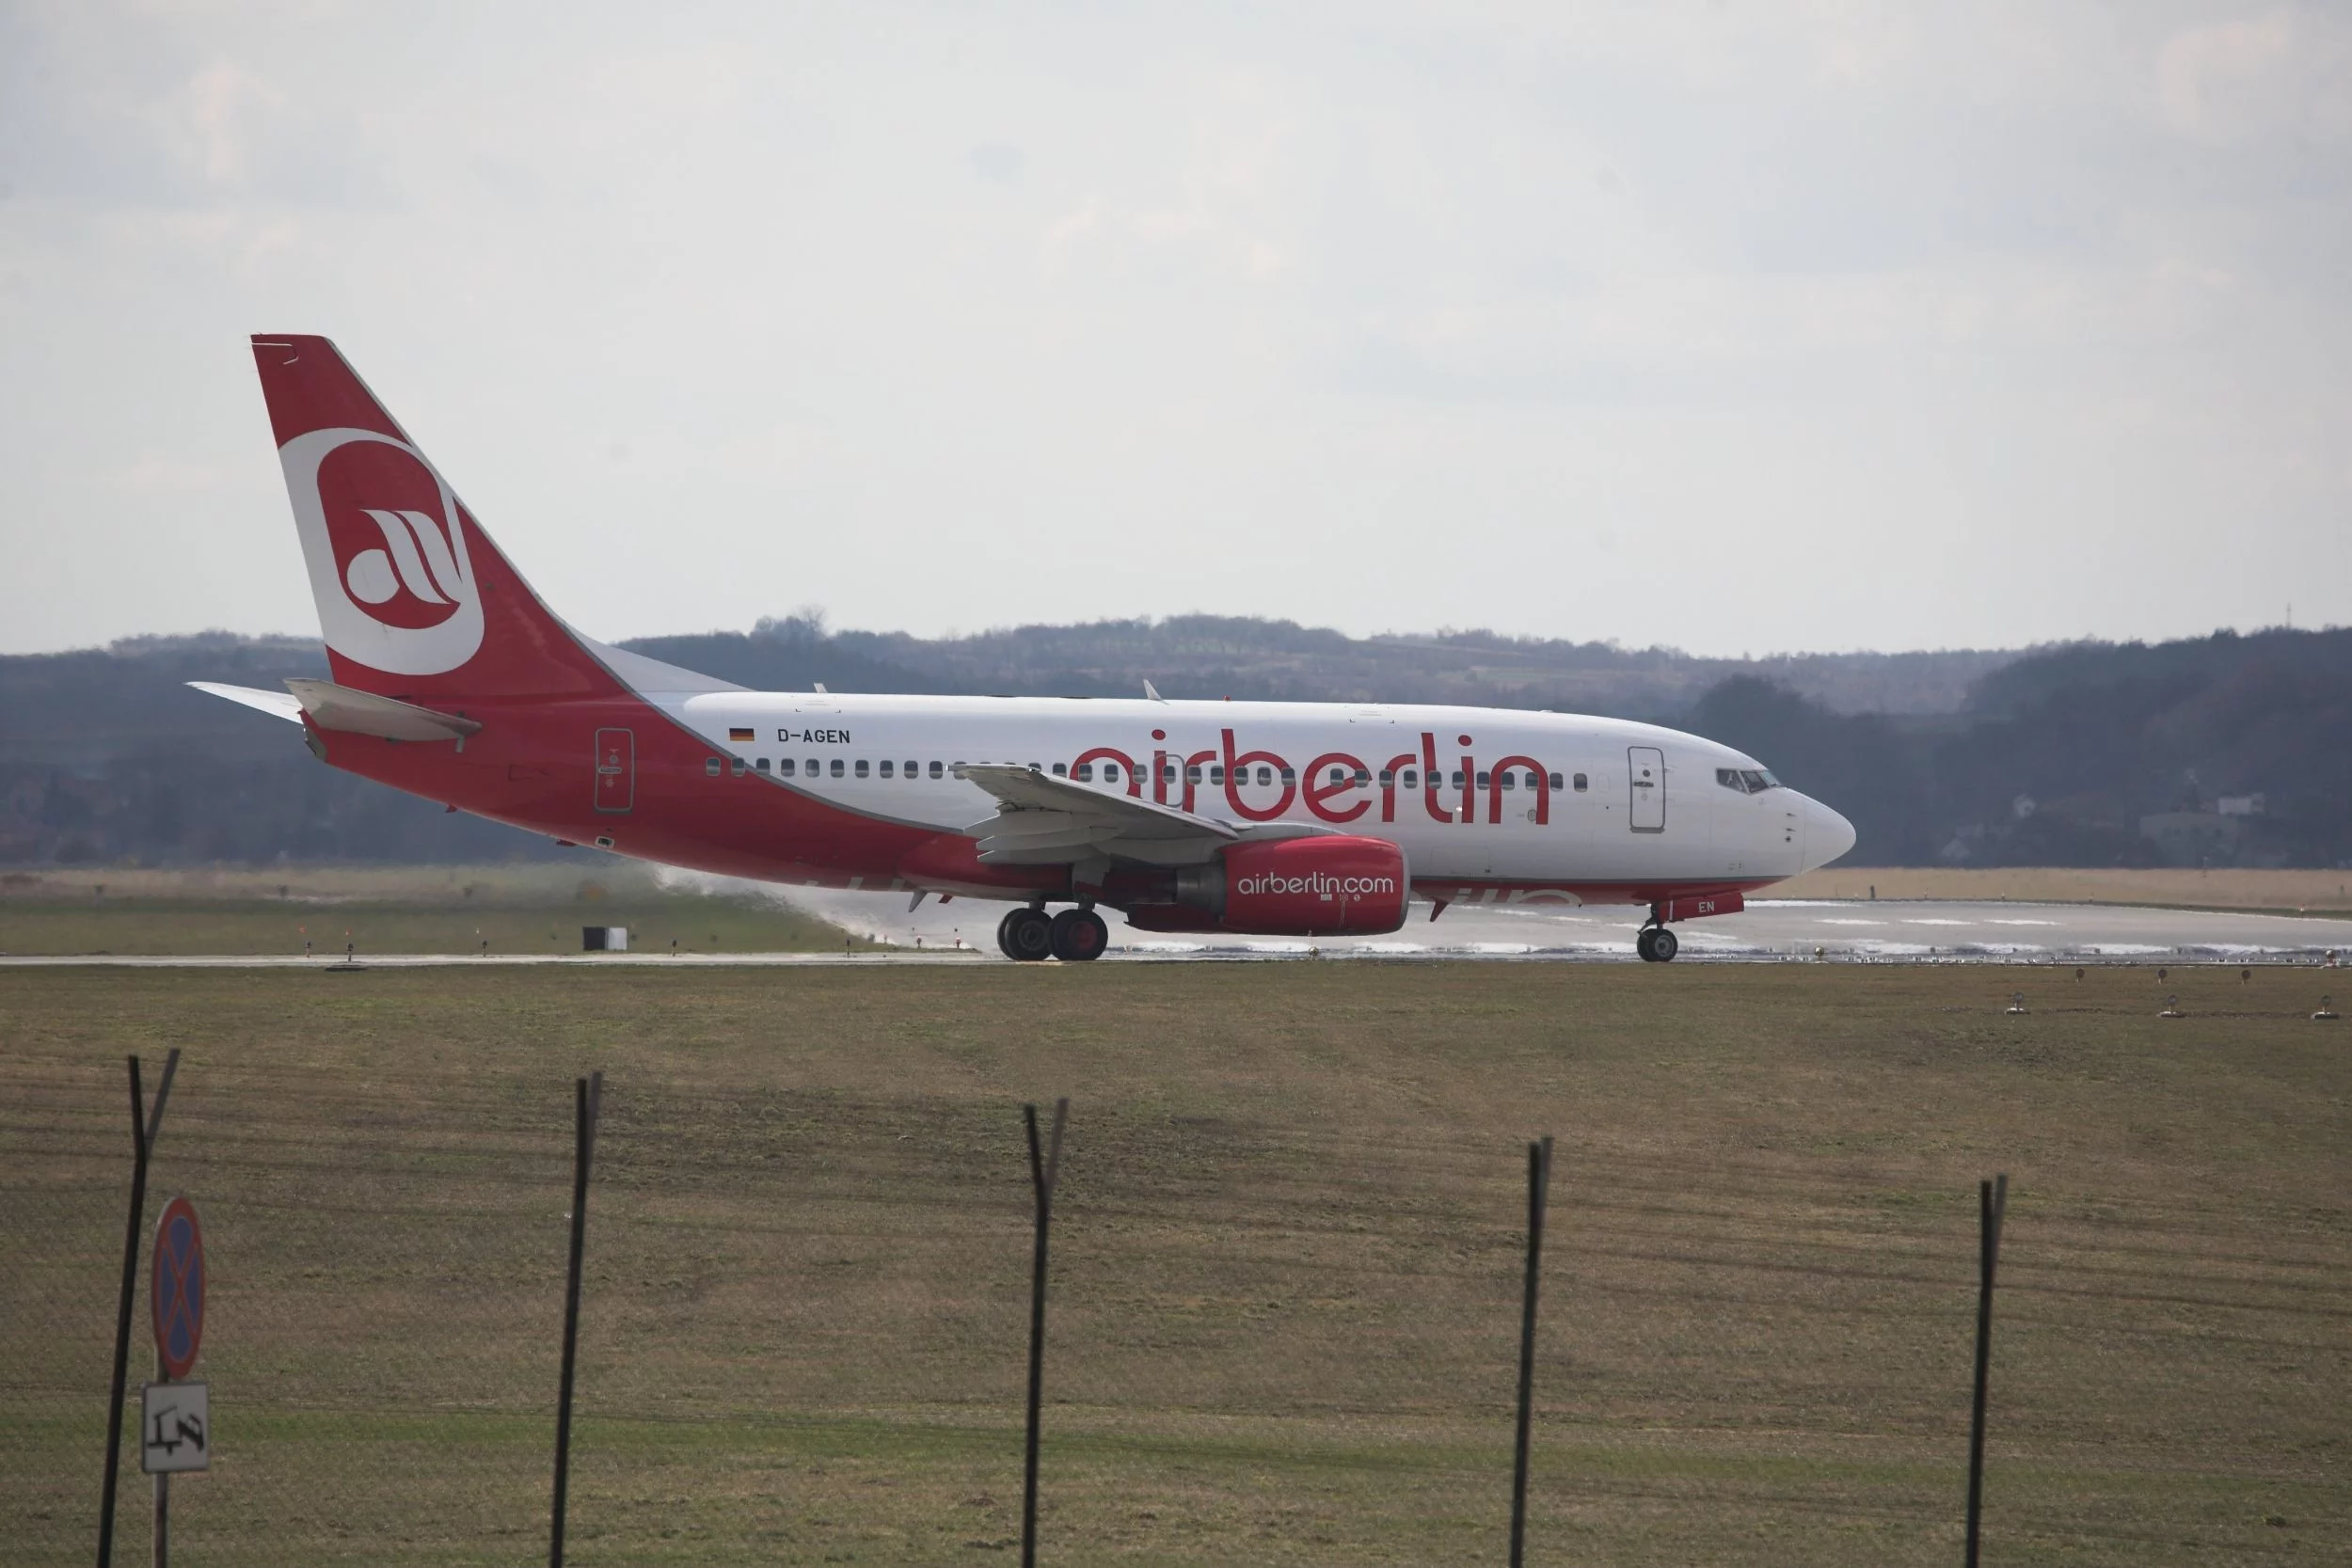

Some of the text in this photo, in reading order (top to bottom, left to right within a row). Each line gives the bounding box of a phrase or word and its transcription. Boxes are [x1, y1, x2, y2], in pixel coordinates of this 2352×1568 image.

[777, 728, 850, 744] D-AGEN
[1237, 871, 1394, 895] airberlin.com
[1698, 901, 1715, 913] EN
